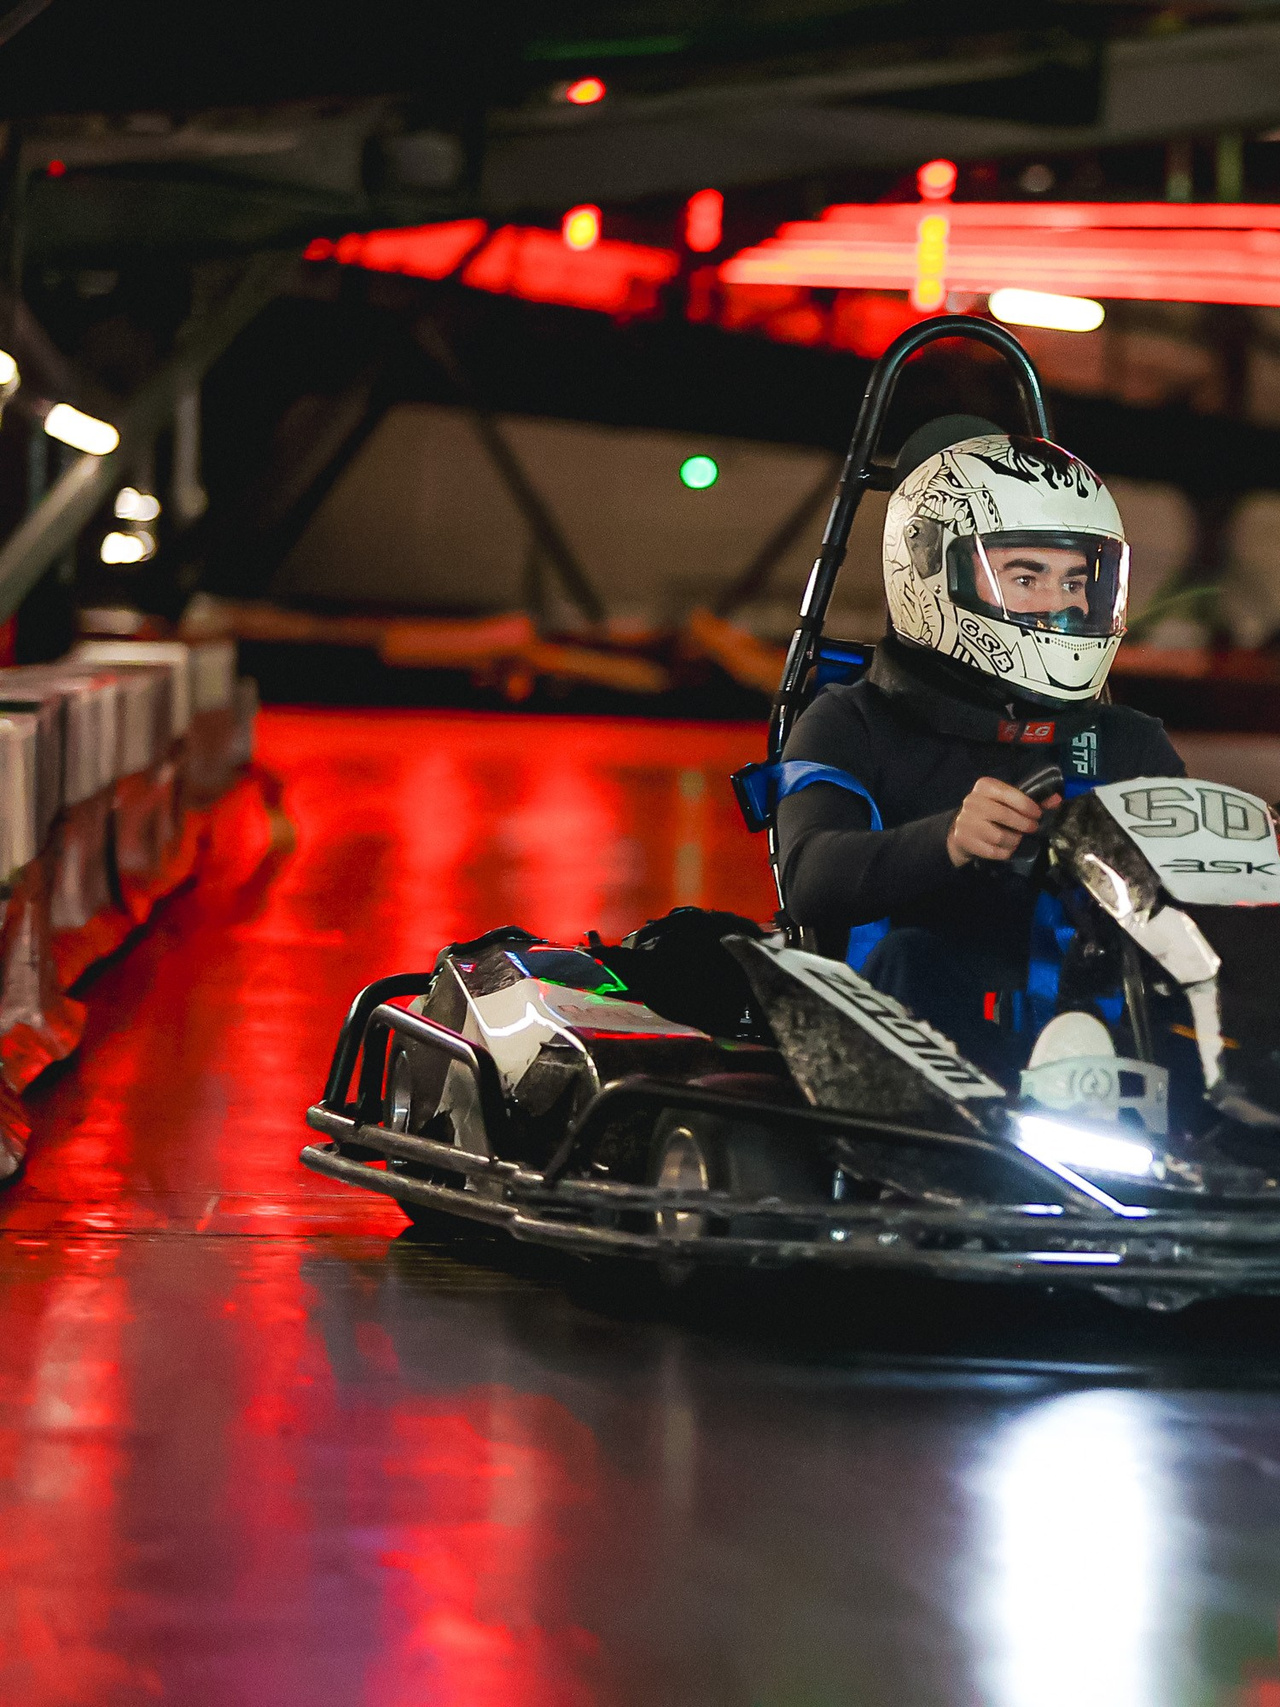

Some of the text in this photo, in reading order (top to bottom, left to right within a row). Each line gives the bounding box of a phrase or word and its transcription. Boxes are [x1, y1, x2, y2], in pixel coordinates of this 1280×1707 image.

[960, 618, 1014, 673] GSB
[1073, 732, 1097, 774] STP
[1119, 786, 1271, 841] 50
[804, 968, 984, 1084] ZOOM
